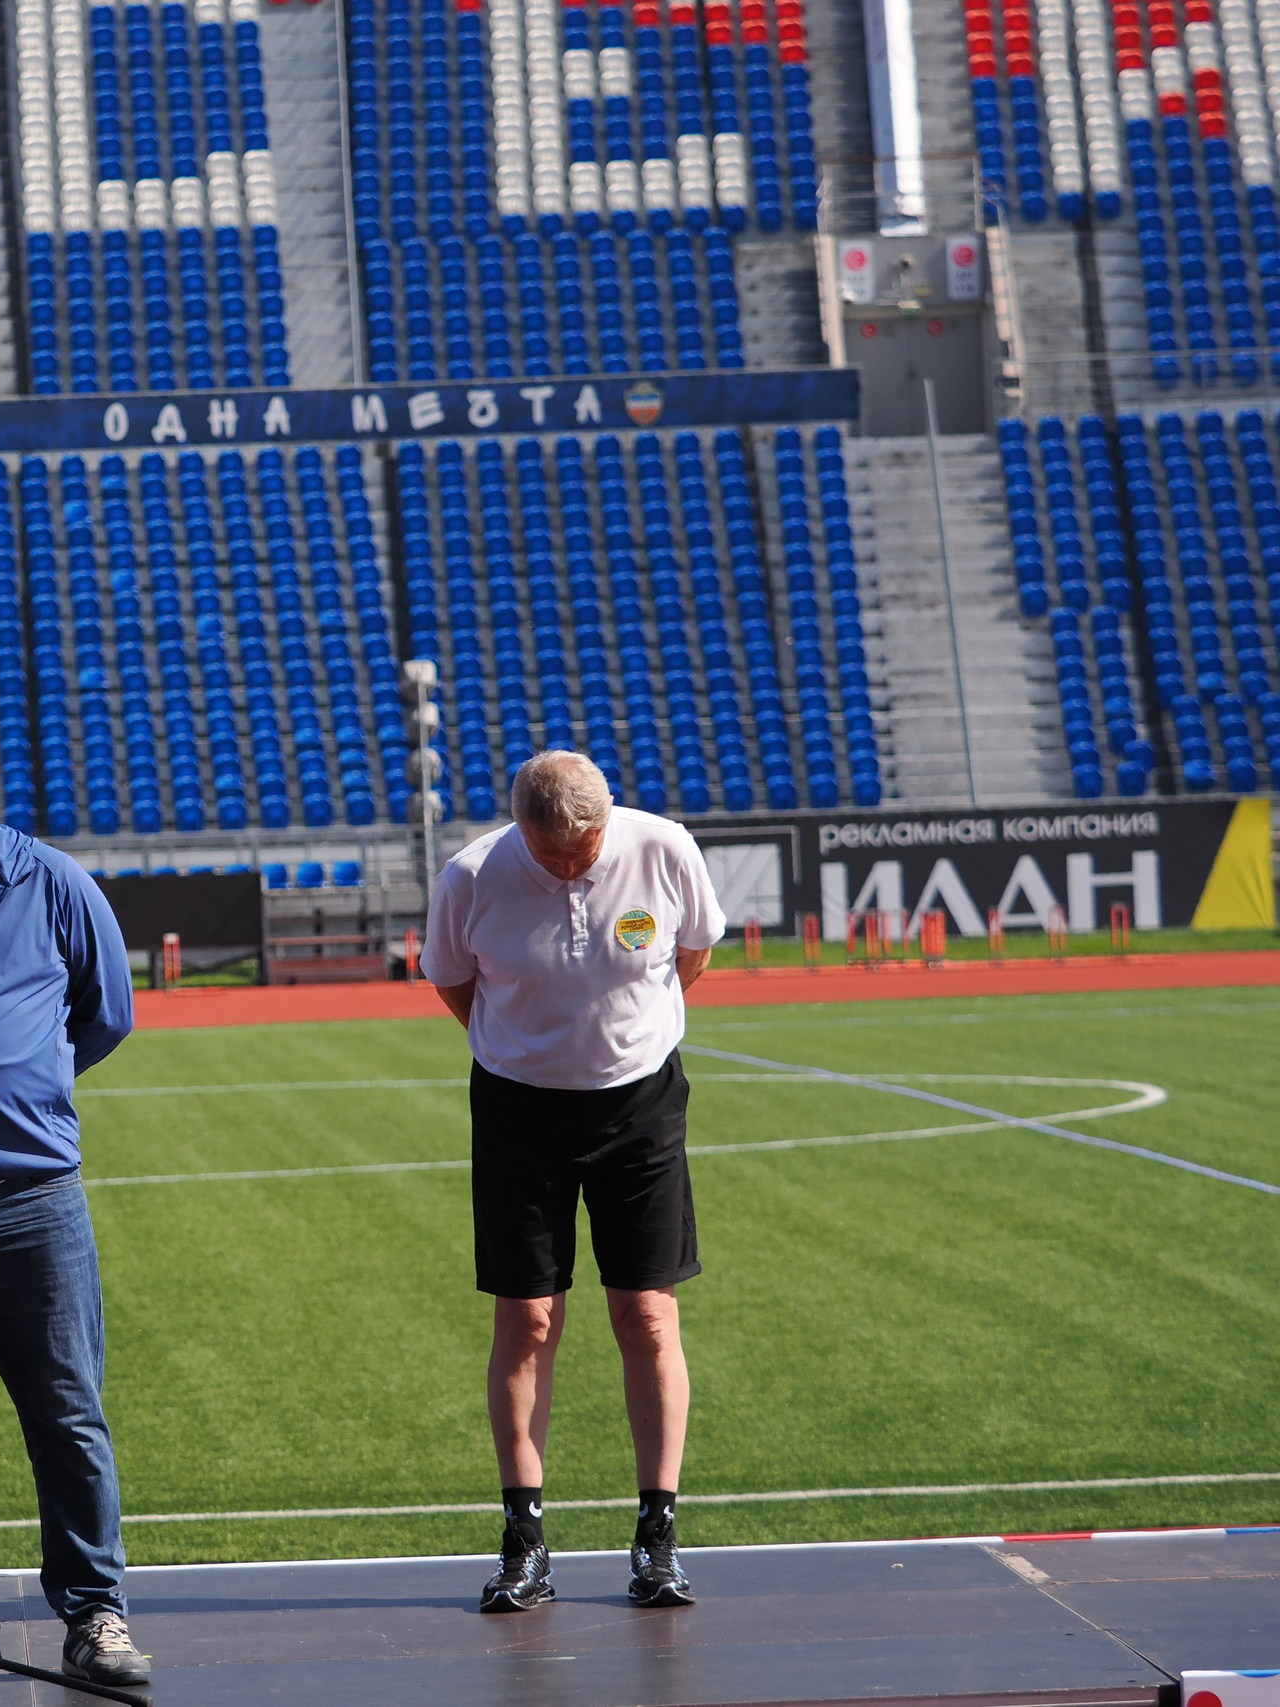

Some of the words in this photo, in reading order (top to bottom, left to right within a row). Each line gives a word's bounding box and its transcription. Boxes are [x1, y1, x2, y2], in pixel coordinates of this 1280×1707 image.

[103, 396, 290, 444] ОДНА
[819, 818, 995, 854] рекламная
[1004, 811, 1158, 844] компания
[822, 850, 1162, 942] ИЛАН
